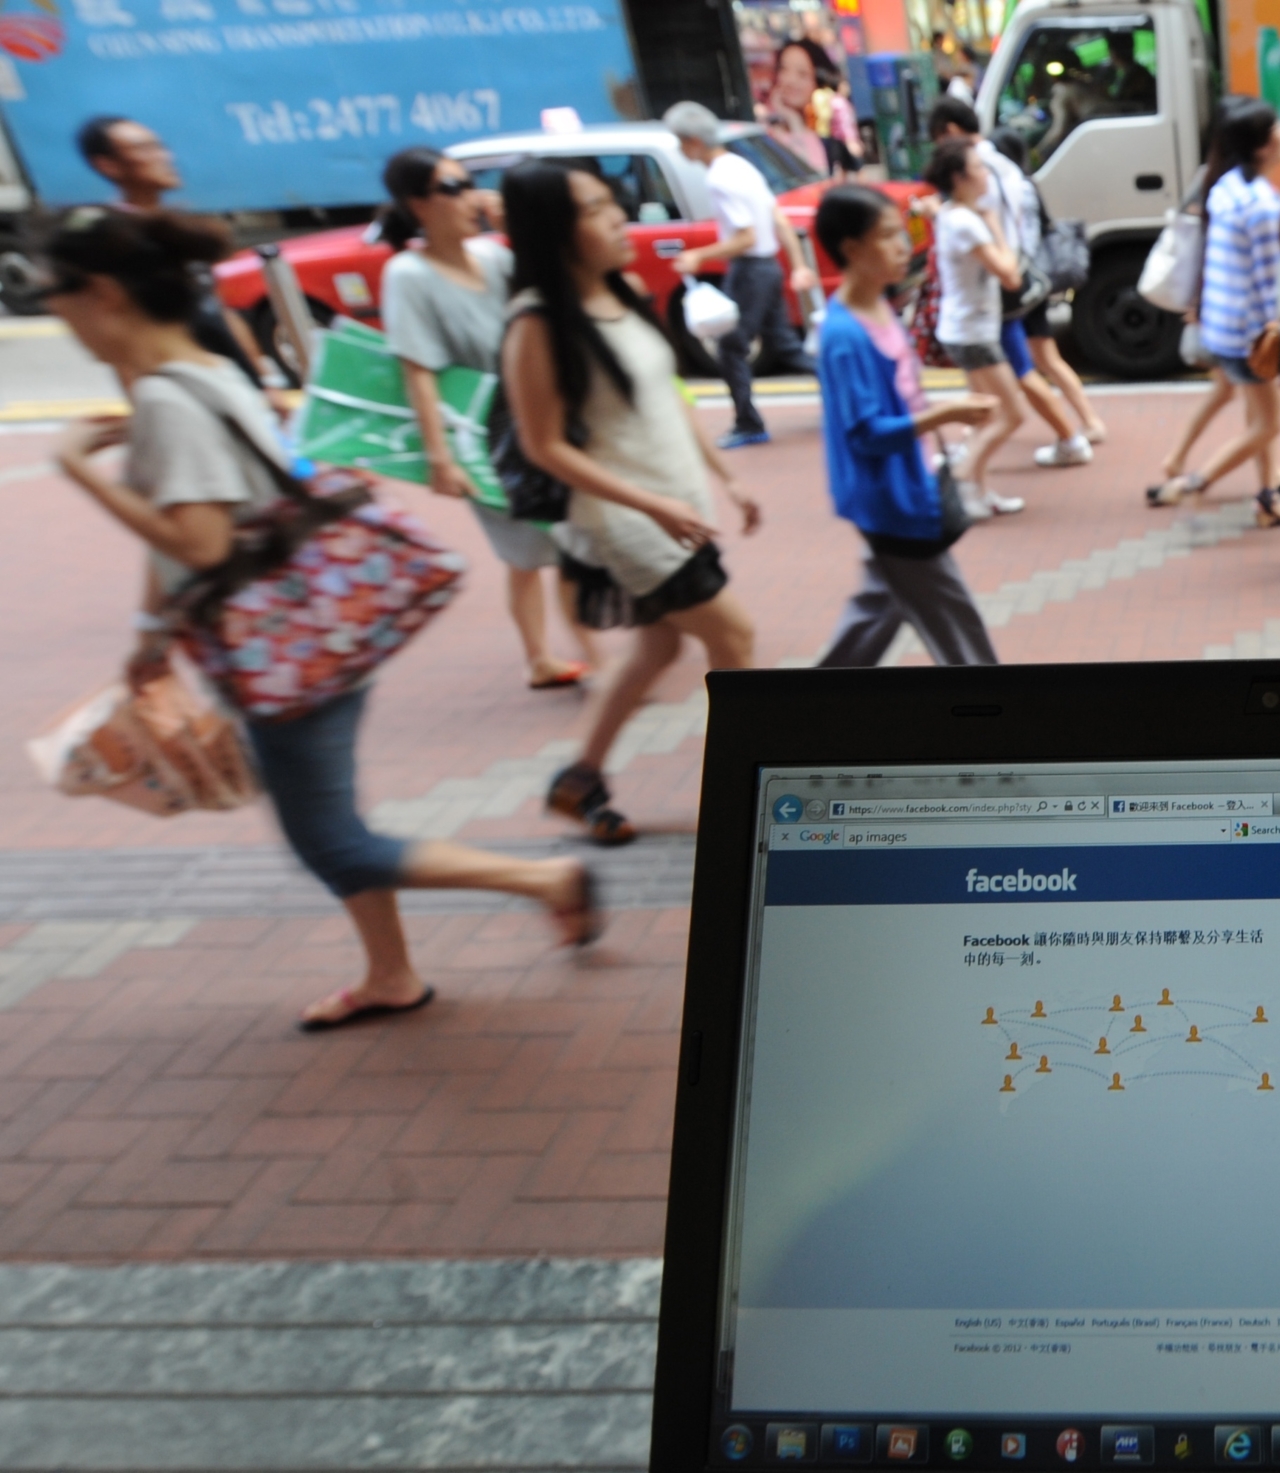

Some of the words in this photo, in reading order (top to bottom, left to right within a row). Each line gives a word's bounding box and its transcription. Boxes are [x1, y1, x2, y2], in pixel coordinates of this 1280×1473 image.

[410, 88, 500, 134] 4067
[849, 801, 1032, 816] https://www.facebook.com/index.php?sty
[1172, 800, 1214, 811] Facebook
[800, 829, 840, 844] Google
[1251, 824, 1280, 835] Search
[849, 833, 863, 844] ap
[866, 831, 907, 845] images
[966, 867, 1077, 892] facebook
[963, 934, 1030, 947] Facebook
[955, 1318, 982, 1328] English
